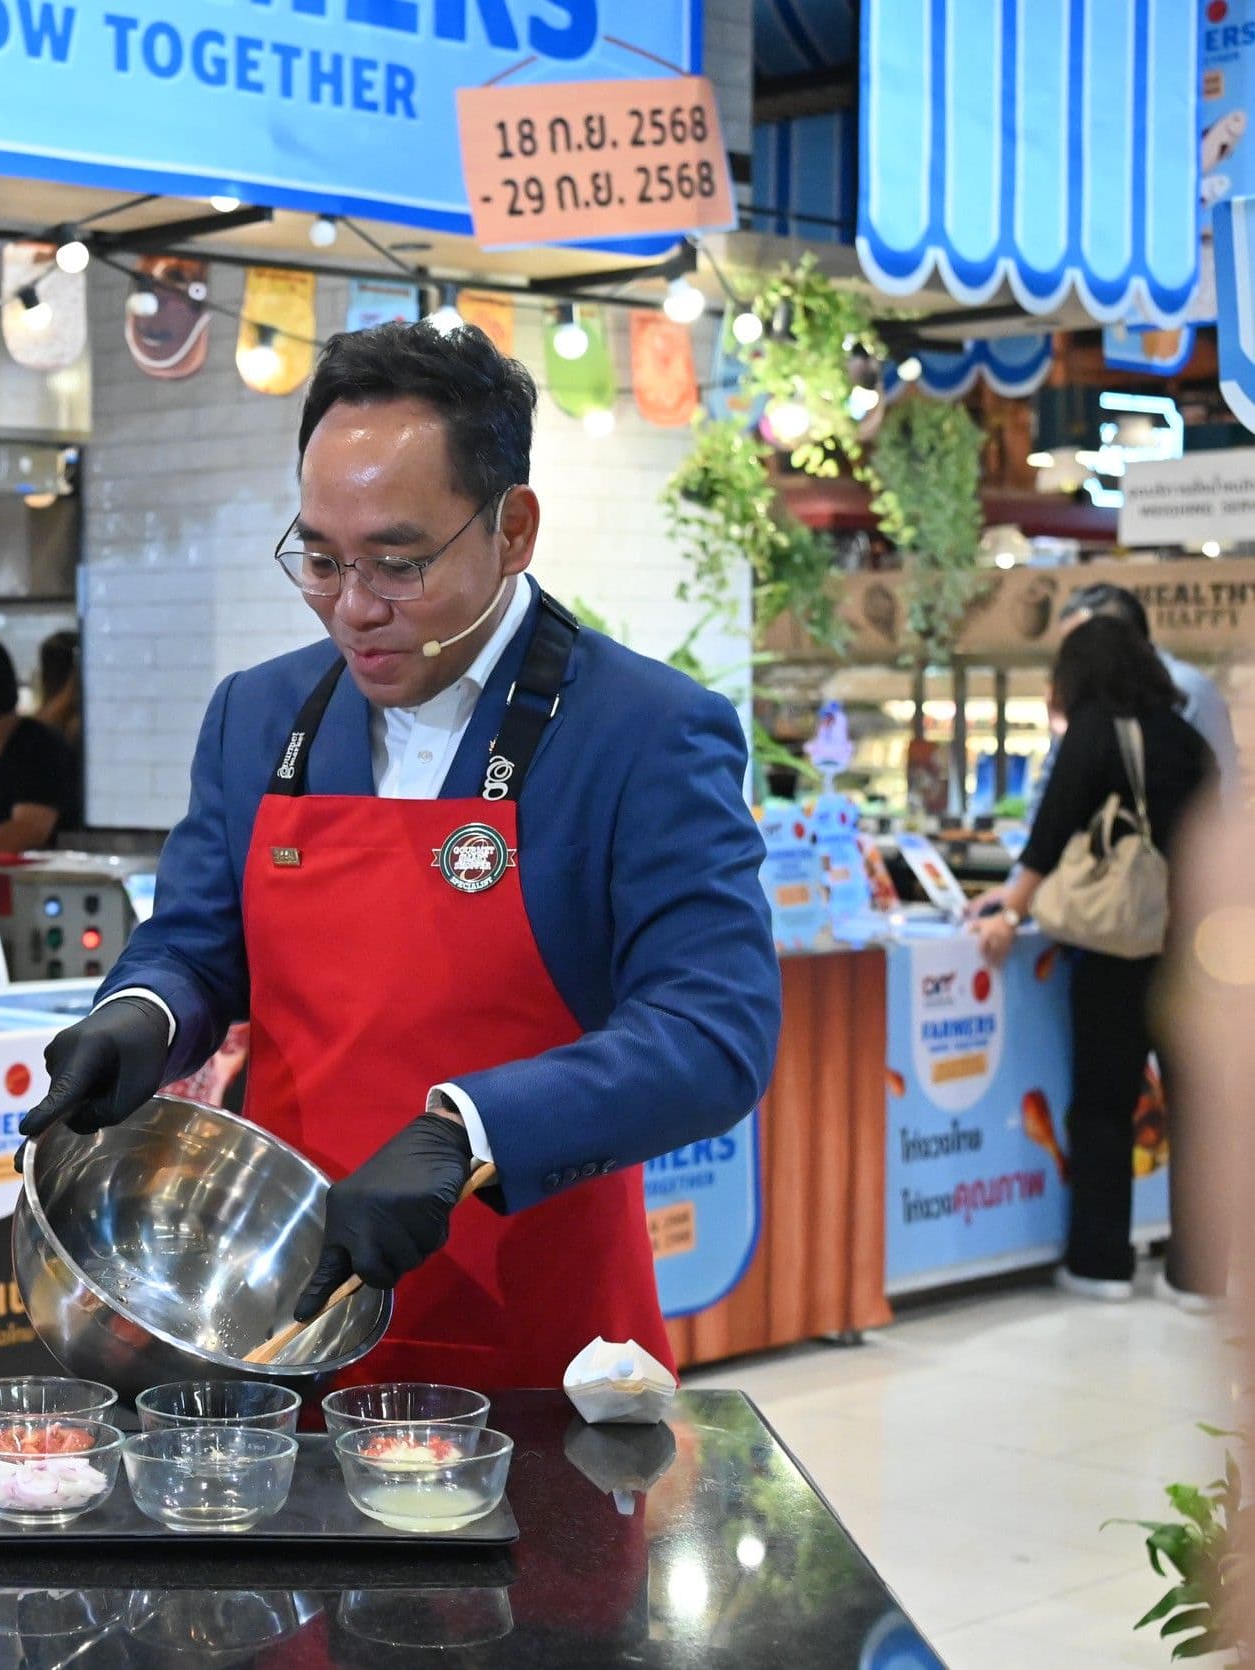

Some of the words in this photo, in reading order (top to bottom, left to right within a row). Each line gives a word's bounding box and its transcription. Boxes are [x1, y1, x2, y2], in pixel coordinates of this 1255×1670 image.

[103, 13, 419, 119] TOGETHER
[496, 118, 538, 159] 18
[548, 113, 619, 153] ก.ย.
[628, 105, 709, 148] 2568
[501, 176, 546, 217] 29
[555, 170, 625, 212] ก.ย.
[635, 160, 716, 204] 2568
